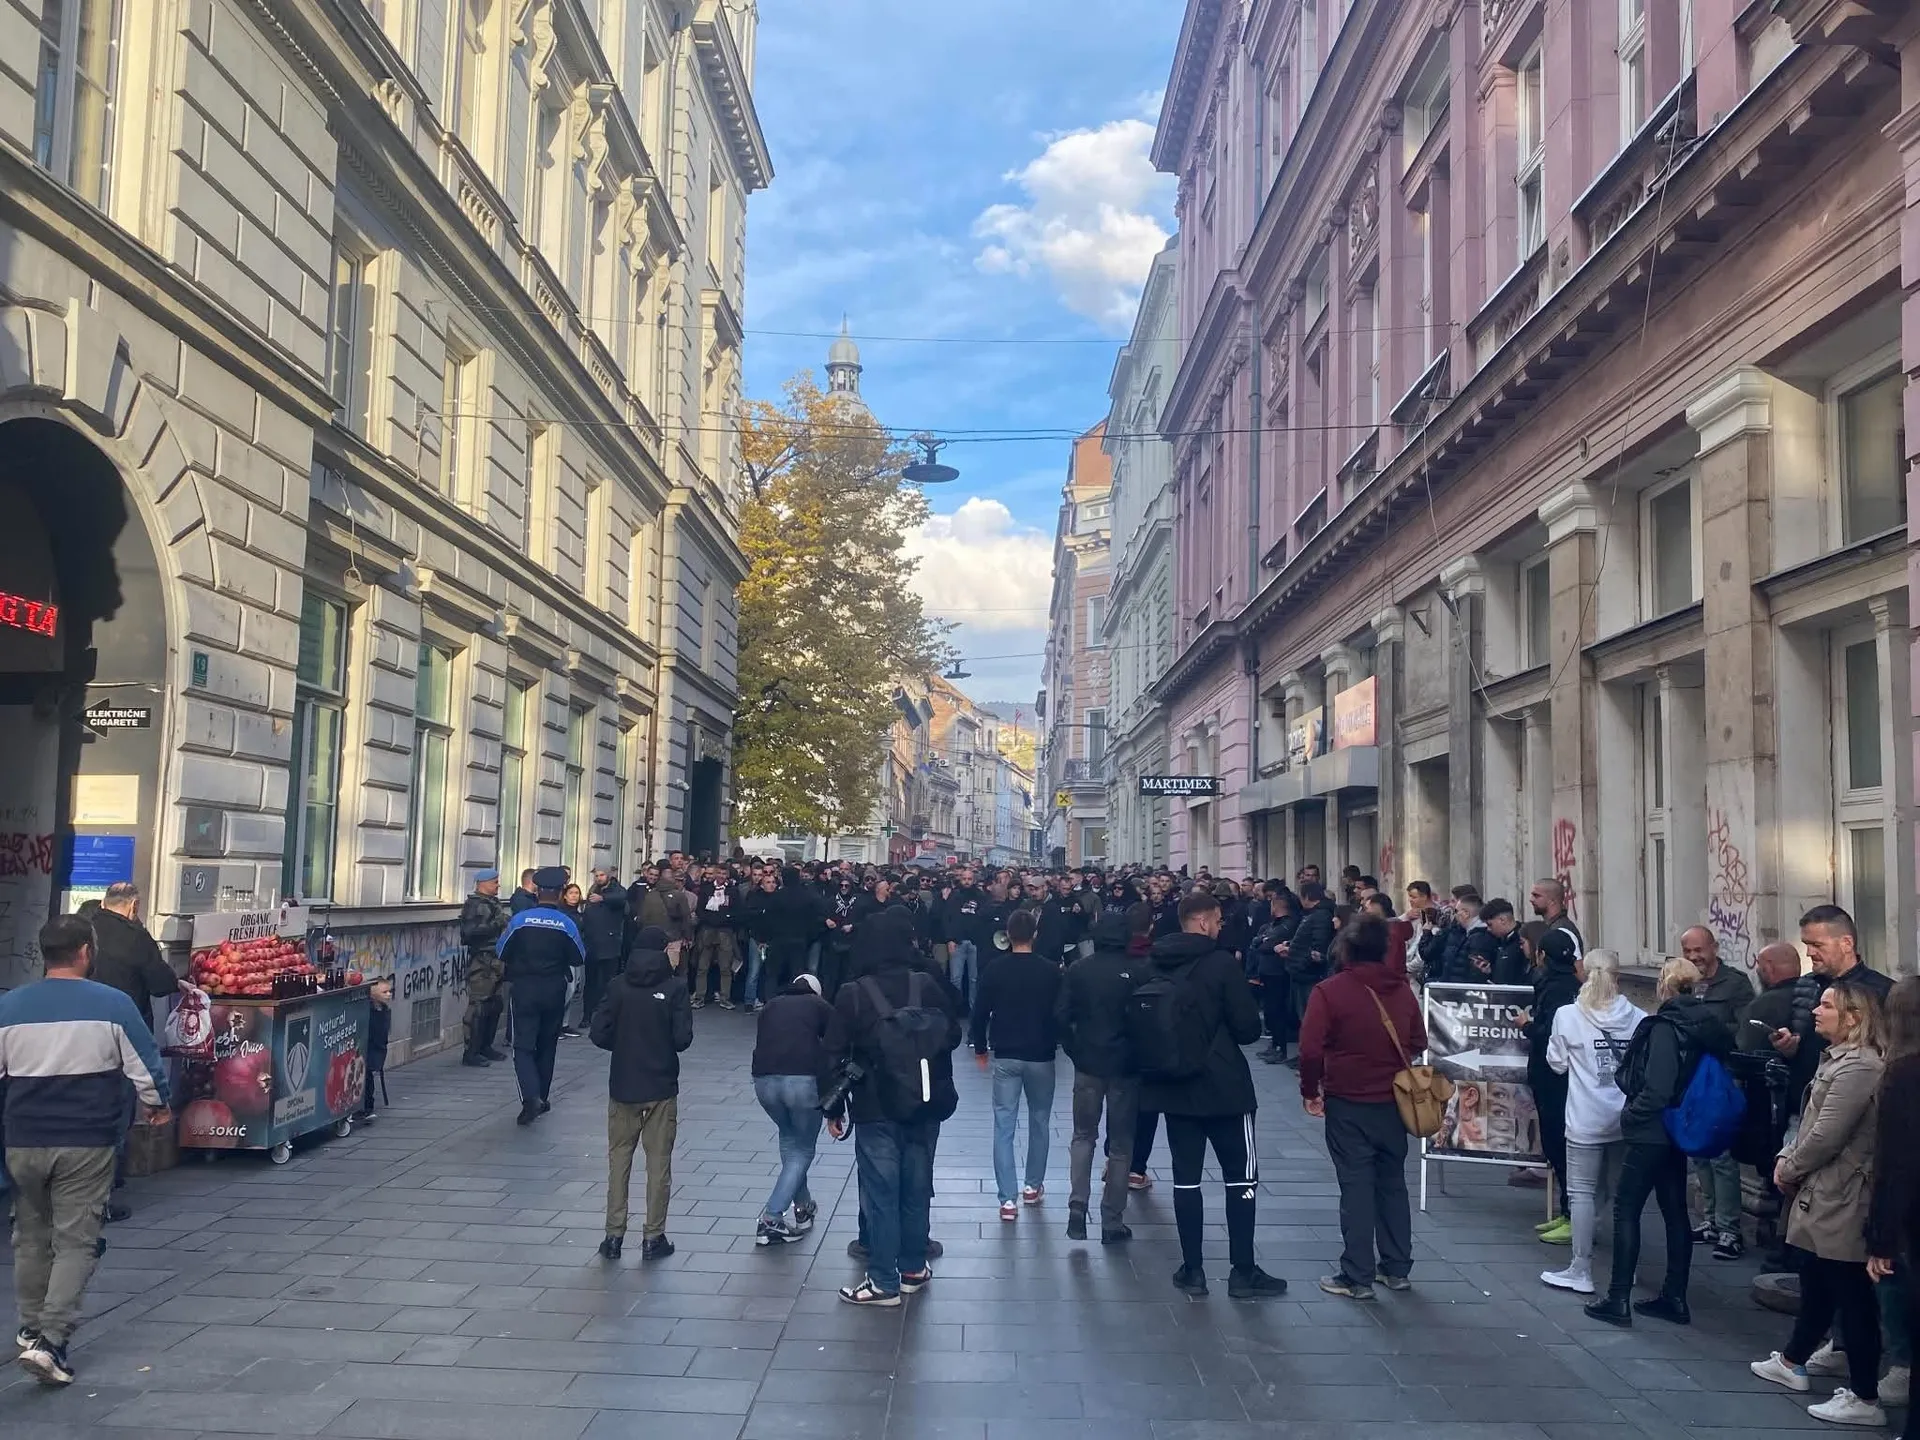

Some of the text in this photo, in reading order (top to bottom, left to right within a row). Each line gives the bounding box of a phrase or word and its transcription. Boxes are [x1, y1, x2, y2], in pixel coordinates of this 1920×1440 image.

[86, 709, 147, 718] ELEKTRIČNE
[89, 718, 139, 726] CIGARETE
[1142, 778, 1212, 790] MARTIMEX
[240, 912, 272, 927] ORGANIC
[524, 917, 566, 929] POLICIJA
[228, 923, 278, 941] FRESH JUICE
[404, 965, 434, 998] GRAD
[318, 1010, 346, 1036] Natural
[323, 1021, 357, 1049] Squeezed
[208, 1124, 247, 1137] SOKIĆ
